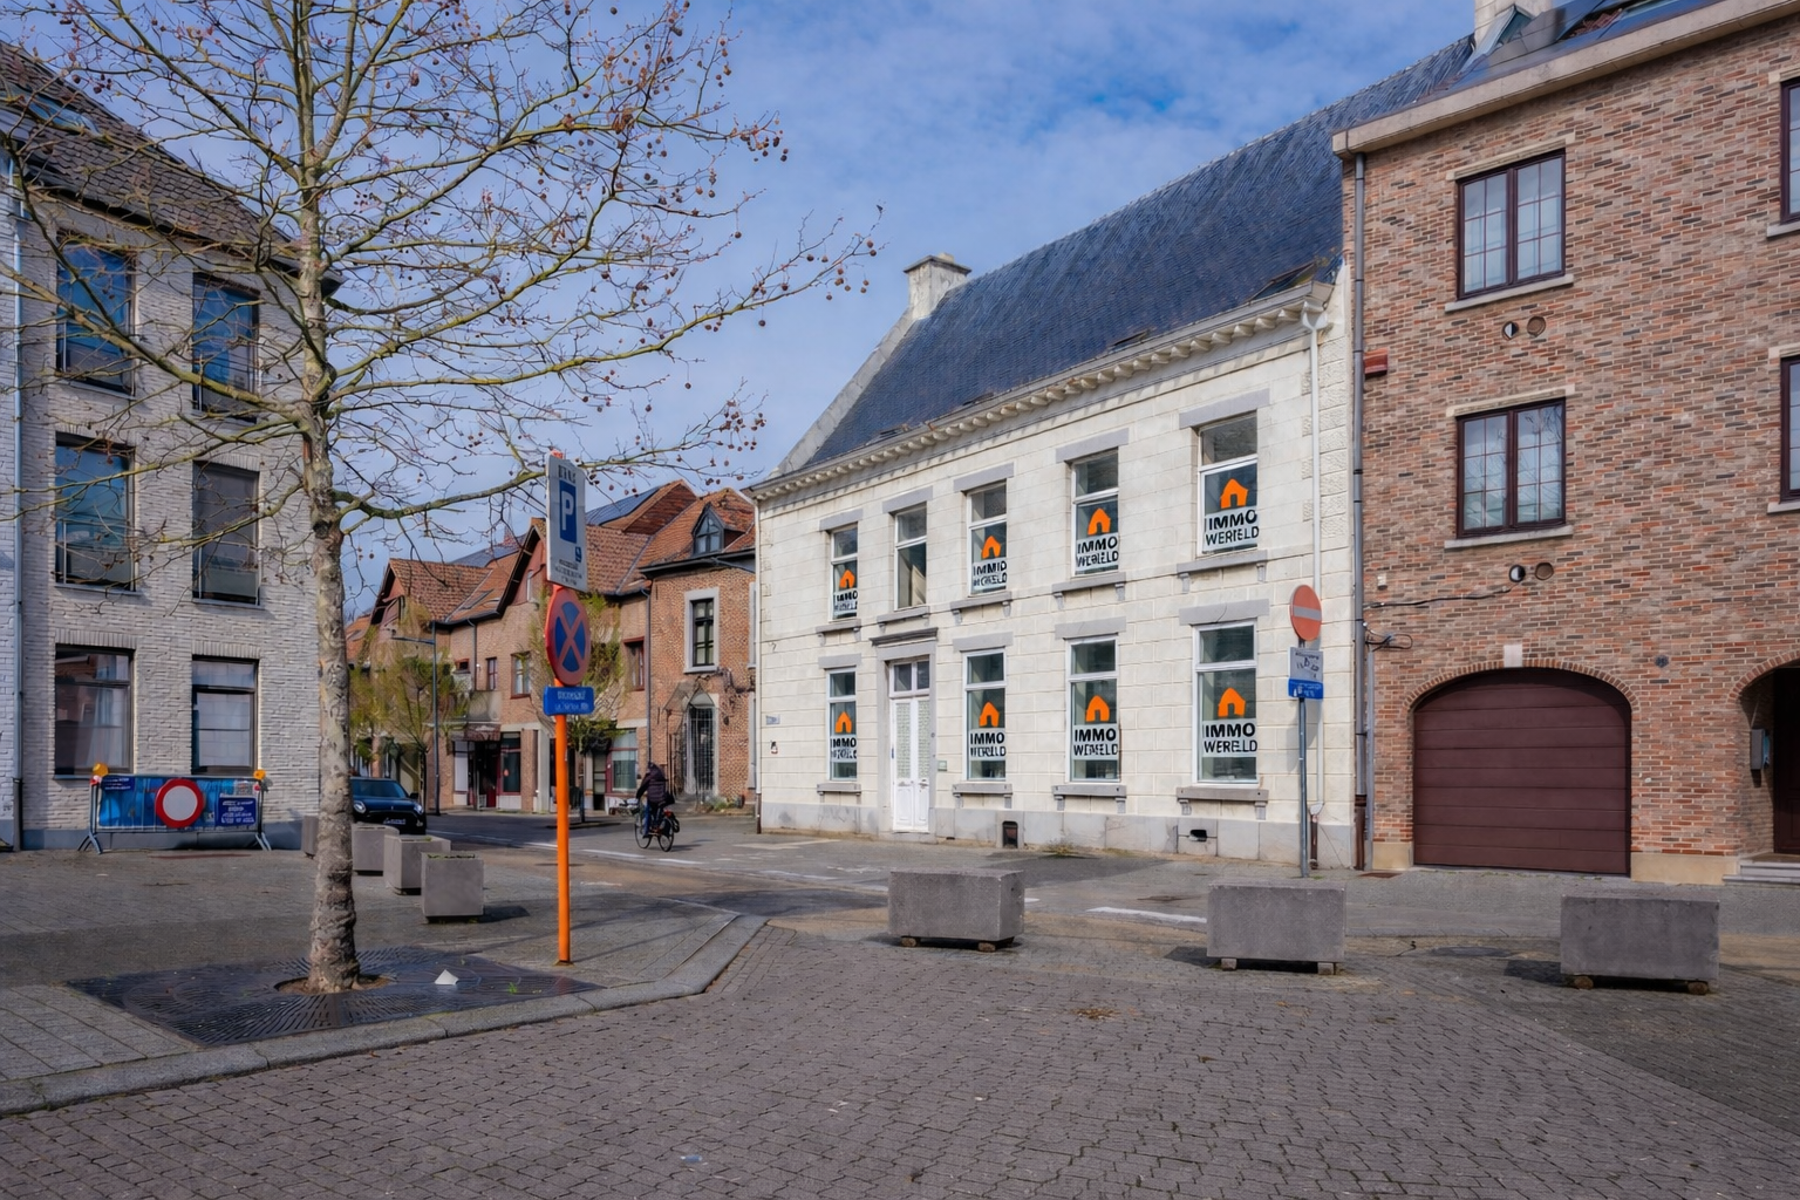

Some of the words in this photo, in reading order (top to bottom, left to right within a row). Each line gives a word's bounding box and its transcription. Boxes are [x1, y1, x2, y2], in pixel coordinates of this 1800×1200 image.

[1209, 509, 1258, 531] IMMO
[1077, 536, 1118, 554] IMMO
[1074, 728, 1117, 742] IMMO
[1204, 722, 1256, 738] IMMO
[970, 732, 1005, 745] IMMO
[1204, 739, 1258, 753] WERELD
